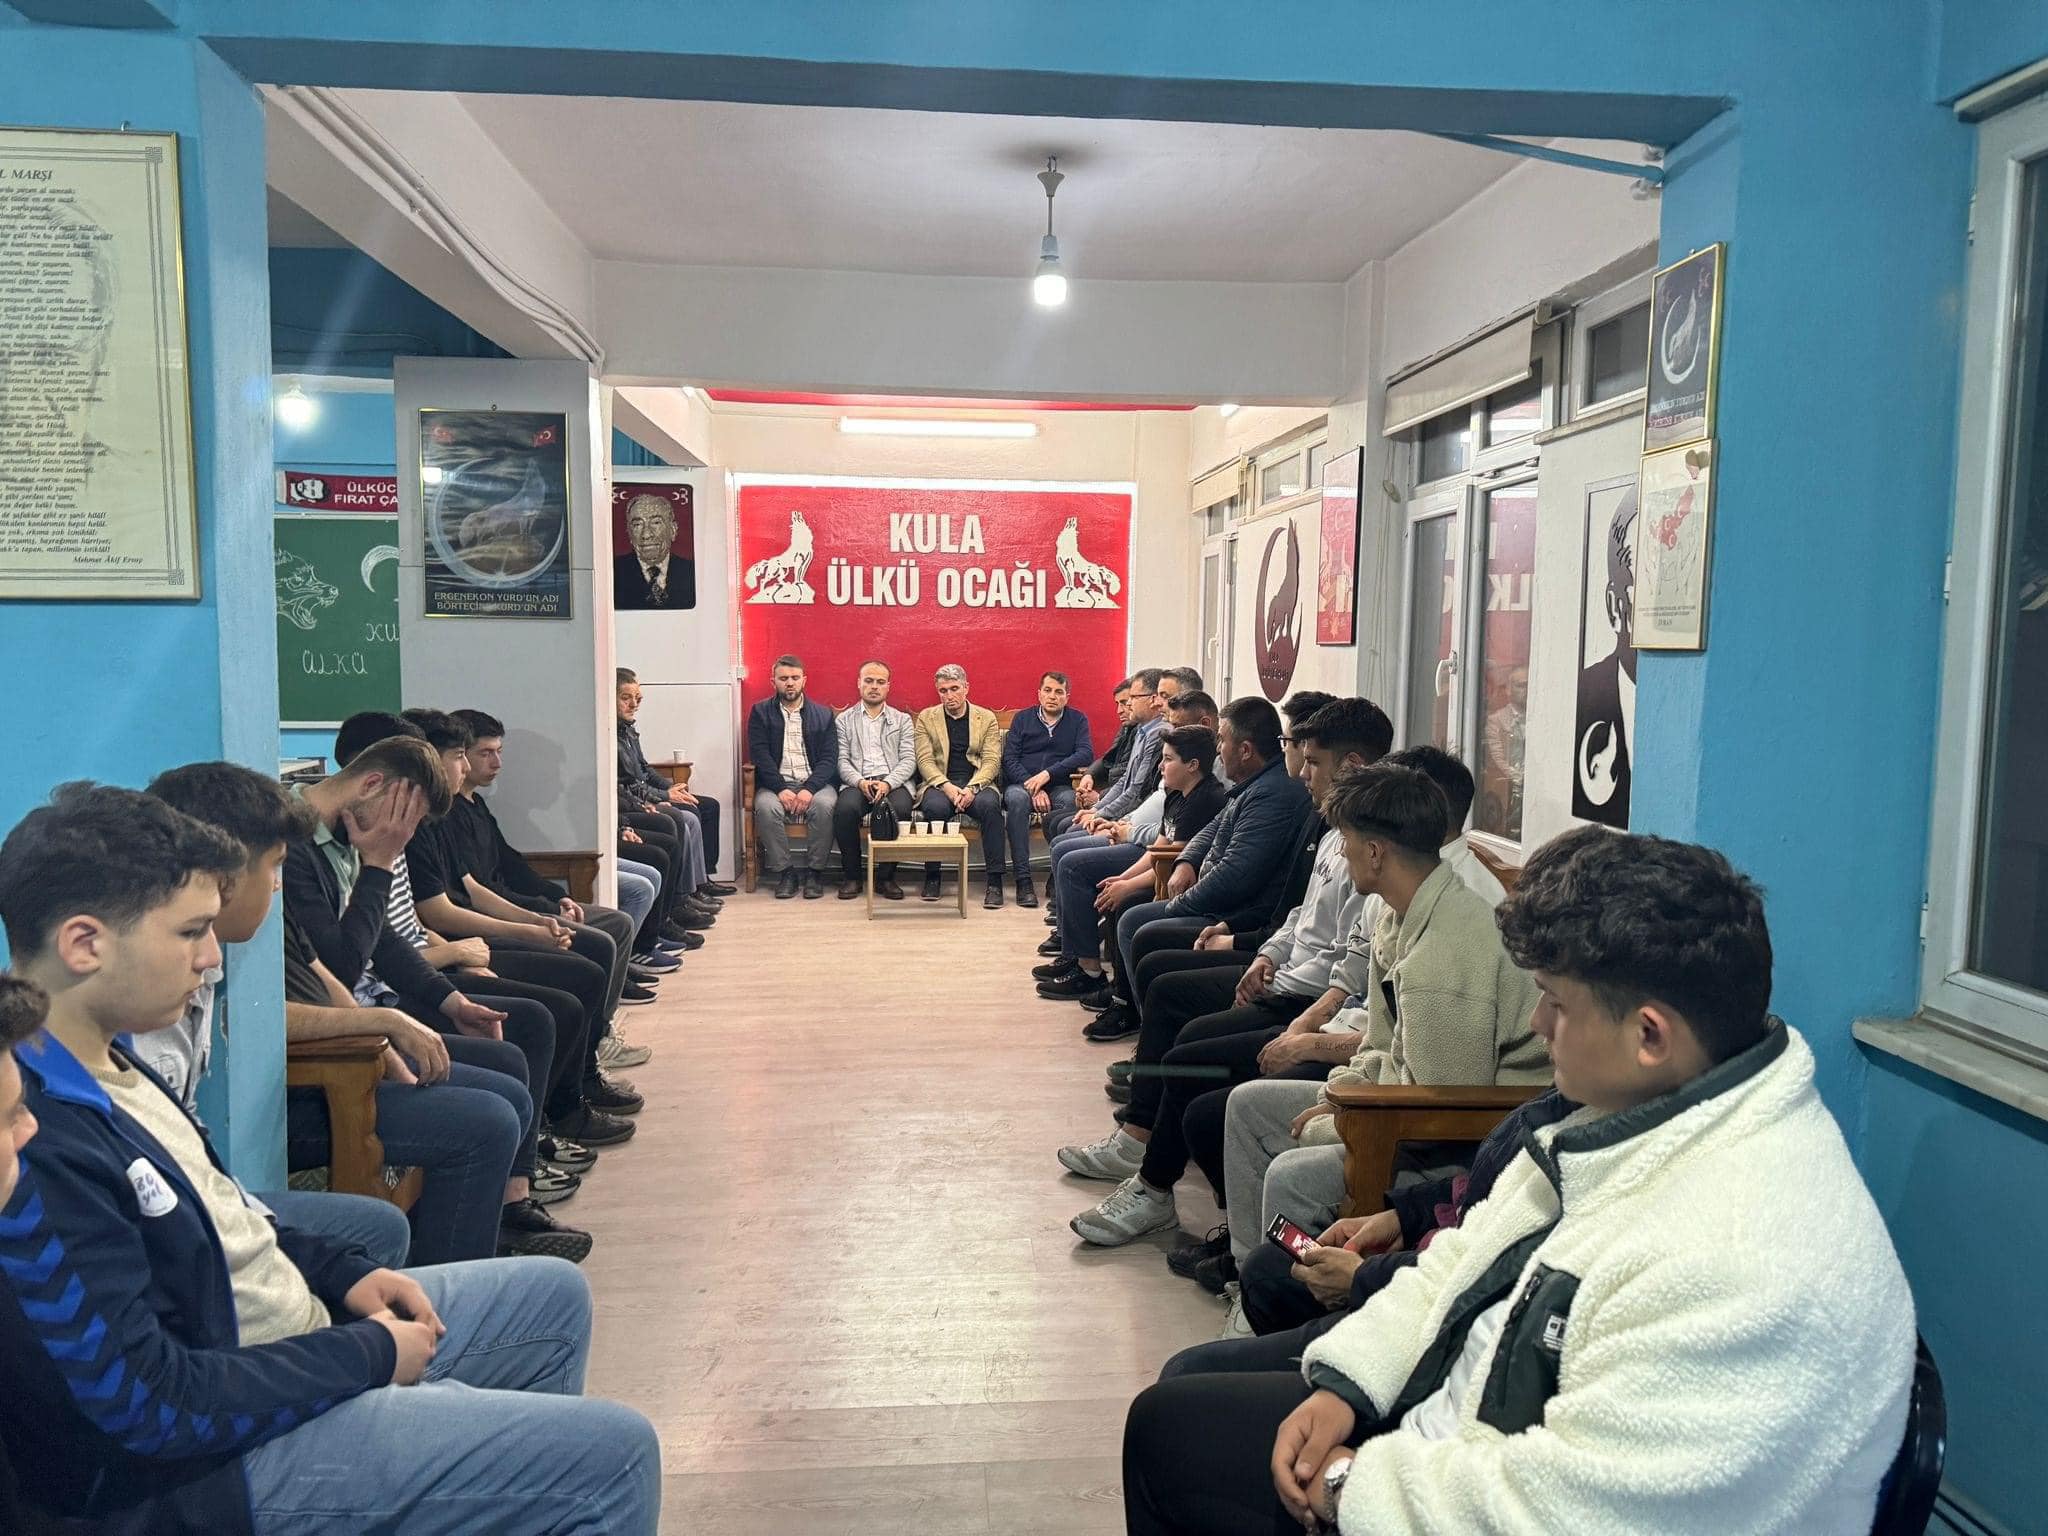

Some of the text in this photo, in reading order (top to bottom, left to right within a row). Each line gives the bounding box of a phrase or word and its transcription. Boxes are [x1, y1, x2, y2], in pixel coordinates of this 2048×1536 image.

[11, 169, 53, 181] MARŞI
[334, 494, 375, 505] FIRAT
[889, 512, 986, 555] KULA
[827, 557, 1047, 608] ÜLKÜ OCAĞI
[434, 592, 494, 601] ERGENEKON
[302, 649, 369, 675] ÜLKÜ
